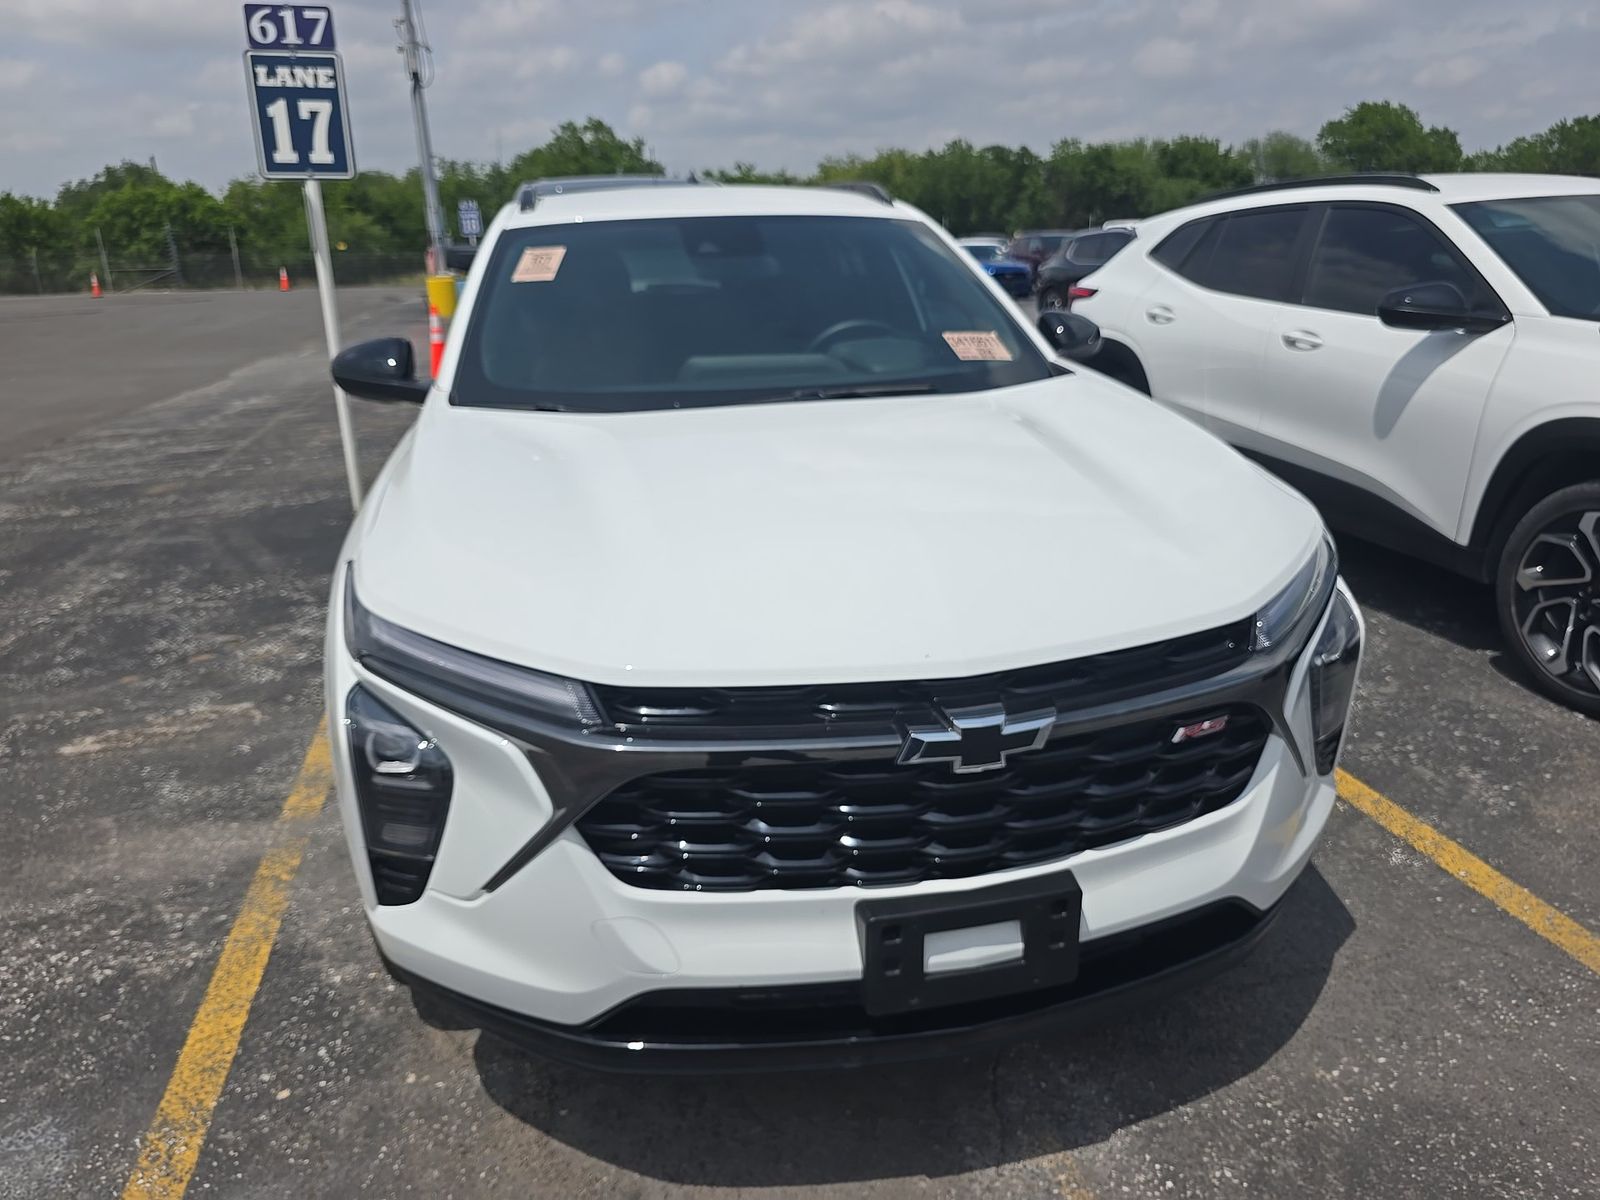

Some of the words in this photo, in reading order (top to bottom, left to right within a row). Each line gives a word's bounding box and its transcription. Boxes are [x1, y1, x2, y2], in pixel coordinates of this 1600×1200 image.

[250, 8, 329, 45] 617
[254, 64, 336, 89] LANE
[265, 97, 335, 164] 17
